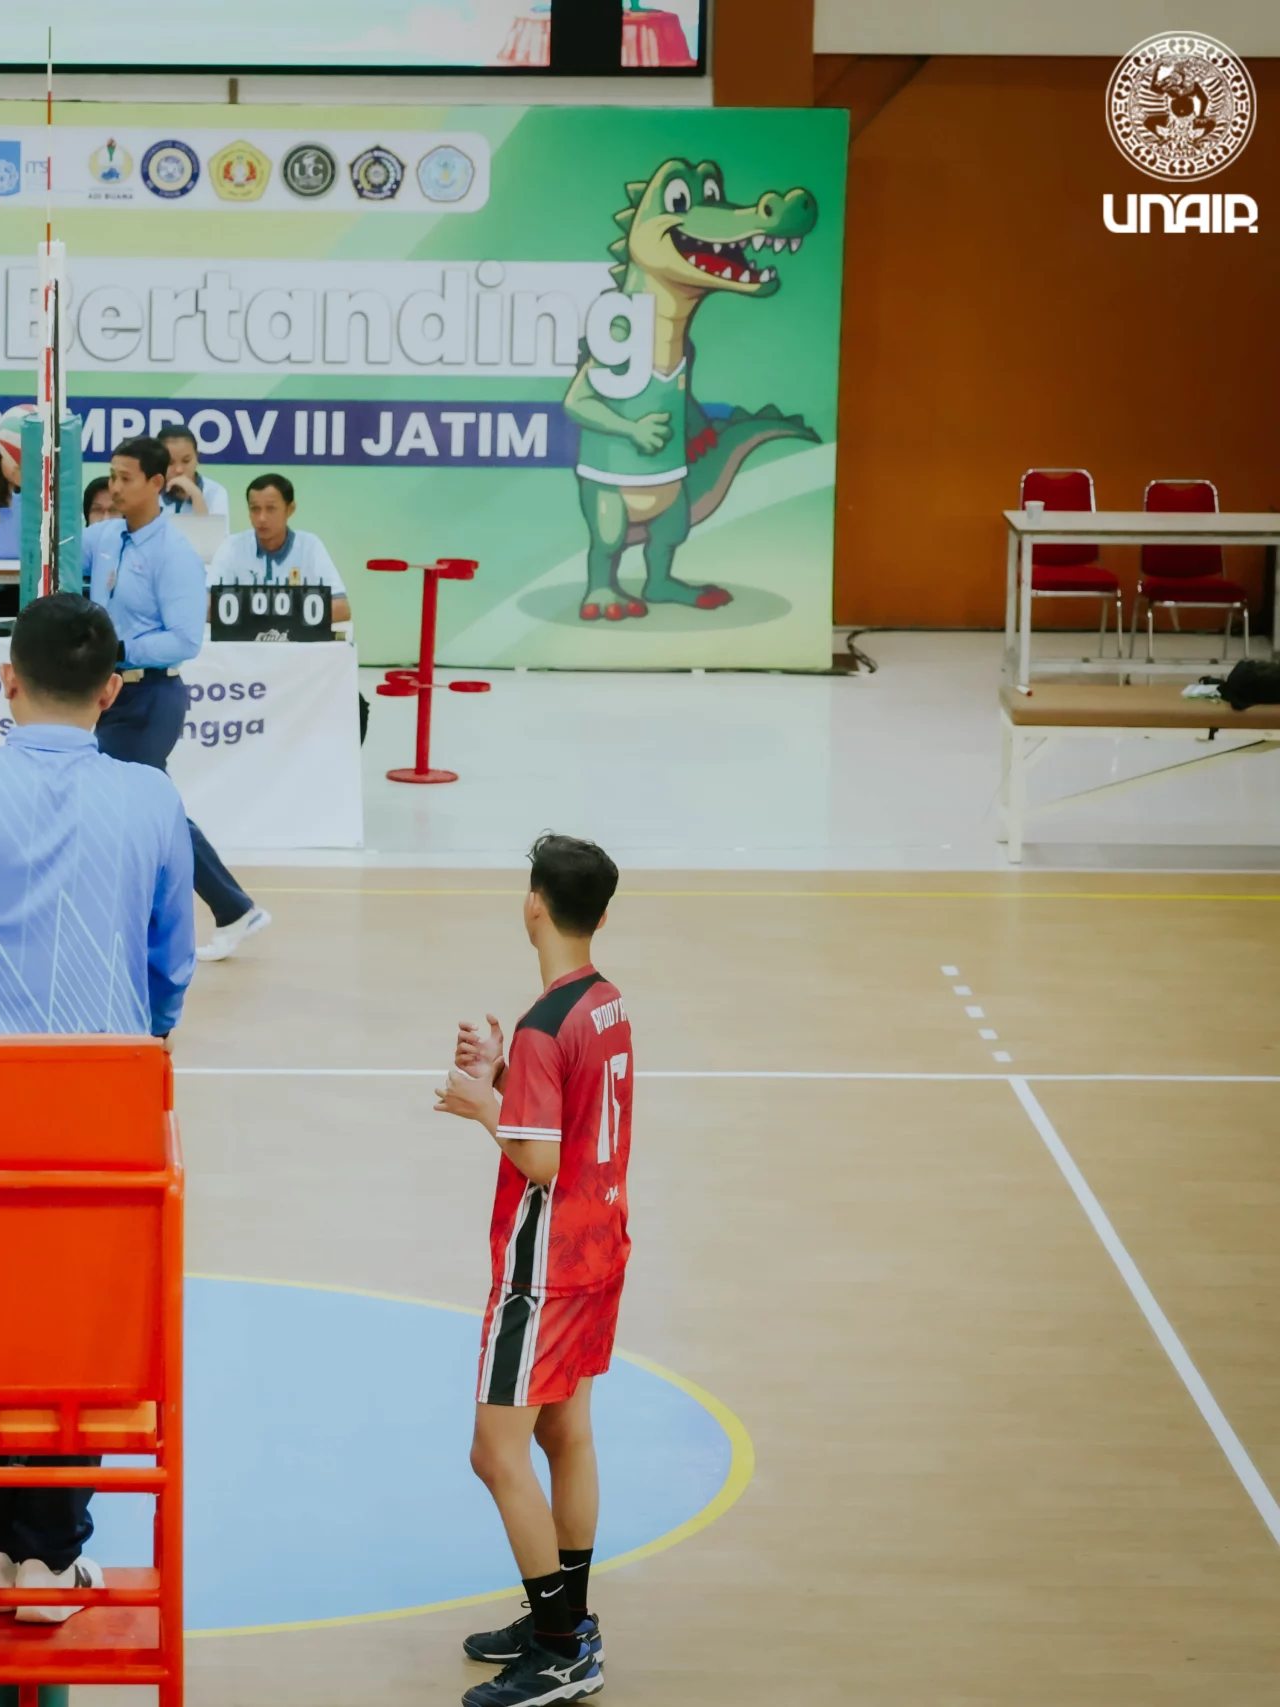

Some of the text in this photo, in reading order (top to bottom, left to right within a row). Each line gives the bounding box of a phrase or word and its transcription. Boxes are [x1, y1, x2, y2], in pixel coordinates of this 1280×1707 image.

[4, 258, 656, 400] Bertanding
[293, 410, 343, 455] III
[360, 411, 549, 459] JATIM
[185, 681, 267, 711] pose
[180, 718, 265, 748] ngga
